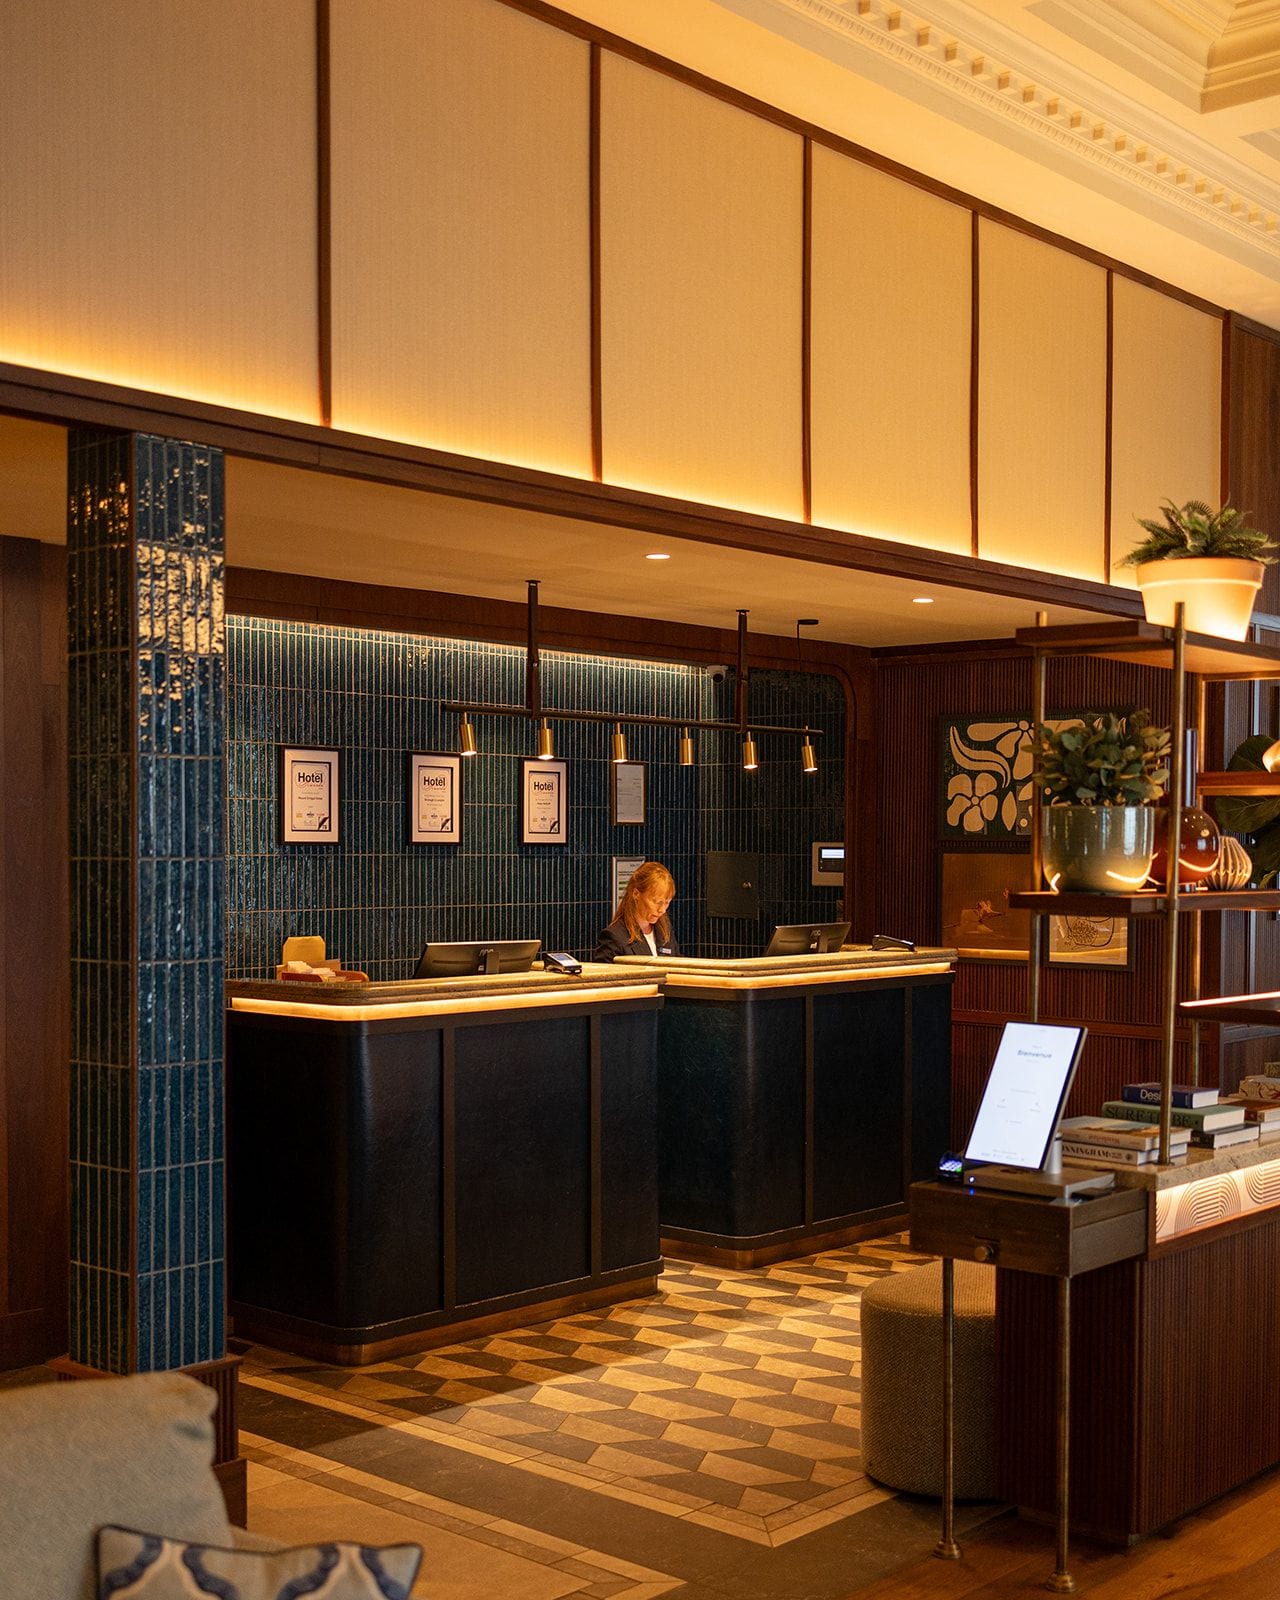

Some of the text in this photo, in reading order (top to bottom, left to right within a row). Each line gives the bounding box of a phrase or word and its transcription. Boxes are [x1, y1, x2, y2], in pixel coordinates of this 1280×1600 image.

[297, 772, 323, 783] Hotel
[423, 776, 446, 787] Hotel
[533, 781, 553, 791] Hotel
[1140, 1089, 1173, 1101] Desi
